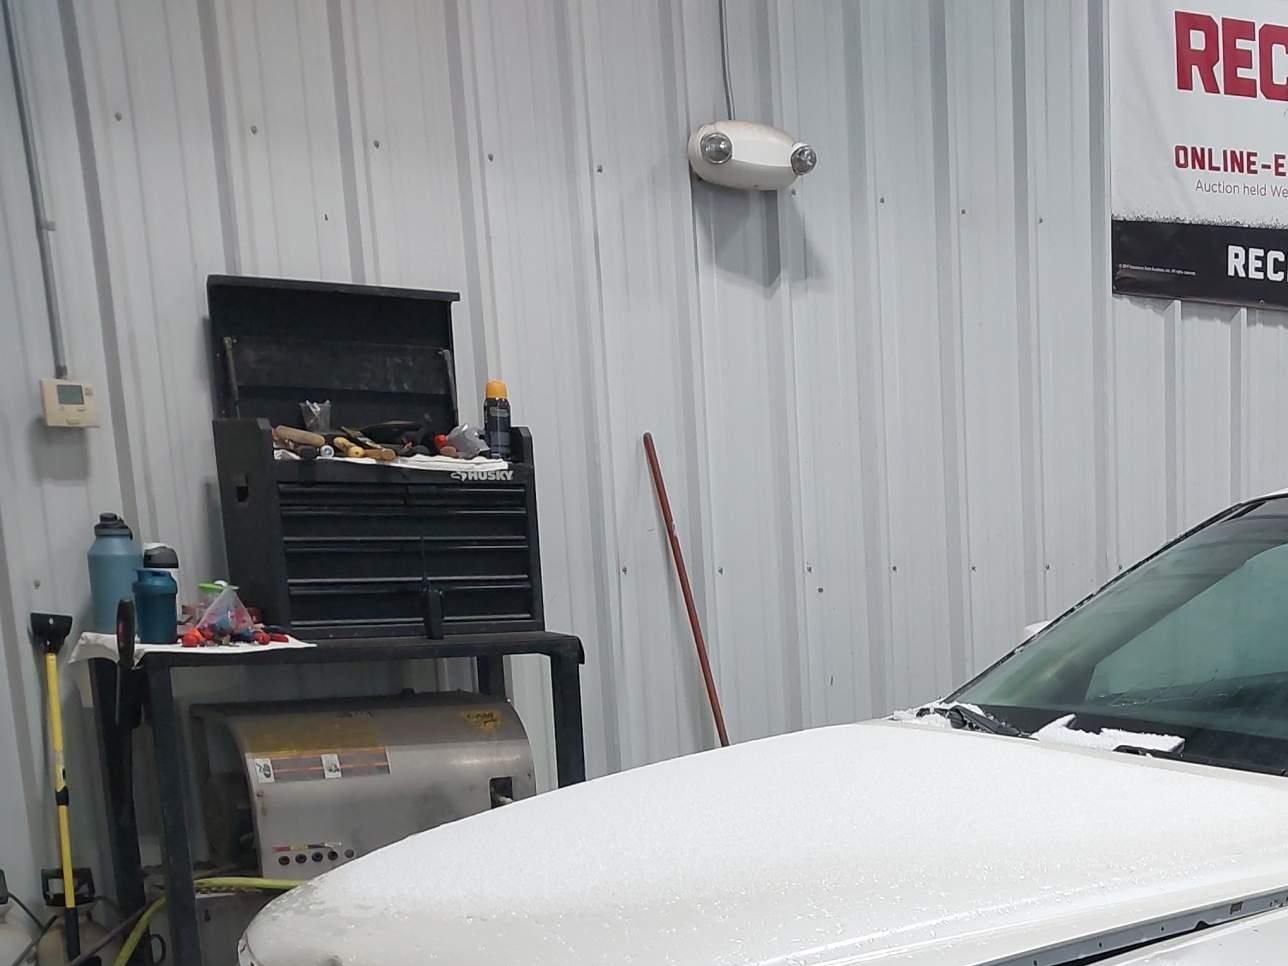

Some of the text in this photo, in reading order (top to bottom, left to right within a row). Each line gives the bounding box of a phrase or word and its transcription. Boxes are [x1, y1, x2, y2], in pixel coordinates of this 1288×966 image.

[1195, 179, 1240, 194] Auction
[1242, 182, 1268, 197] held
[468, 470, 514, 481] HUSKY
